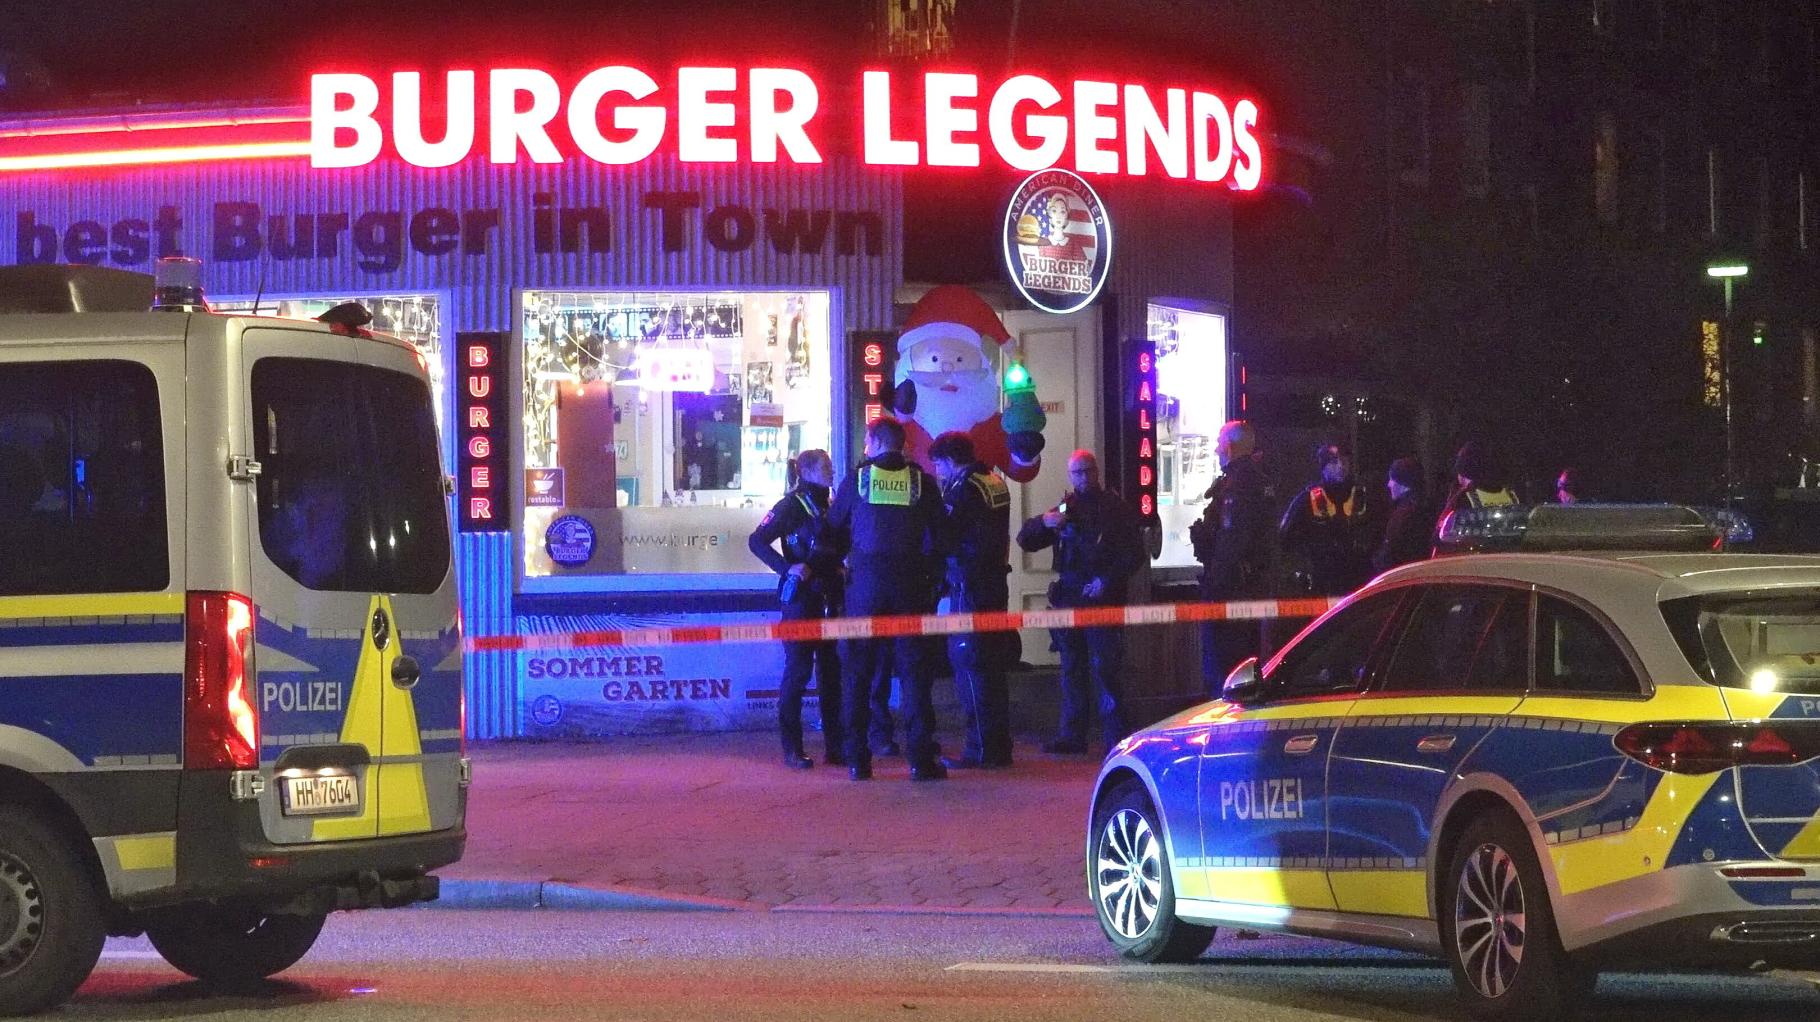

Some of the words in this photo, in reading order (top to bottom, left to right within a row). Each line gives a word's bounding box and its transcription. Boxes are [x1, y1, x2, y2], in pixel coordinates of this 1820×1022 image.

[311, 66, 823, 167] BURGER
[863, 71, 1262, 190] LEGENDS
[1011, 174, 1067, 222] AMERICAN
[1074, 179, 1104, 226] DINER
[16, 205, 184, 266] best
[213, 202, 499, 274] Burger
[533, 191, 611, 254] in
[644, 191, 883, 256] Town
[1024, 272, 1092, 293] LEGENDS
[1028, 257, 1088, 277] BURGER
[864, 345, 882, 425] STE
[469, 346, 491, 518] BURGER
[1140, 353, 1152, 515] SALADS
[872, 479, 908, 492] POLIZEI
[527, 655, 665, 679] SOMMER
[263, 682, 342, 712] POLIZEI
[602, 678, 731, 701] GARTEN
[296, 780, 314, 806] HH
[321, 779, 351, 804] 7604
[1220, 778, 1303, 820] POLIZEI
